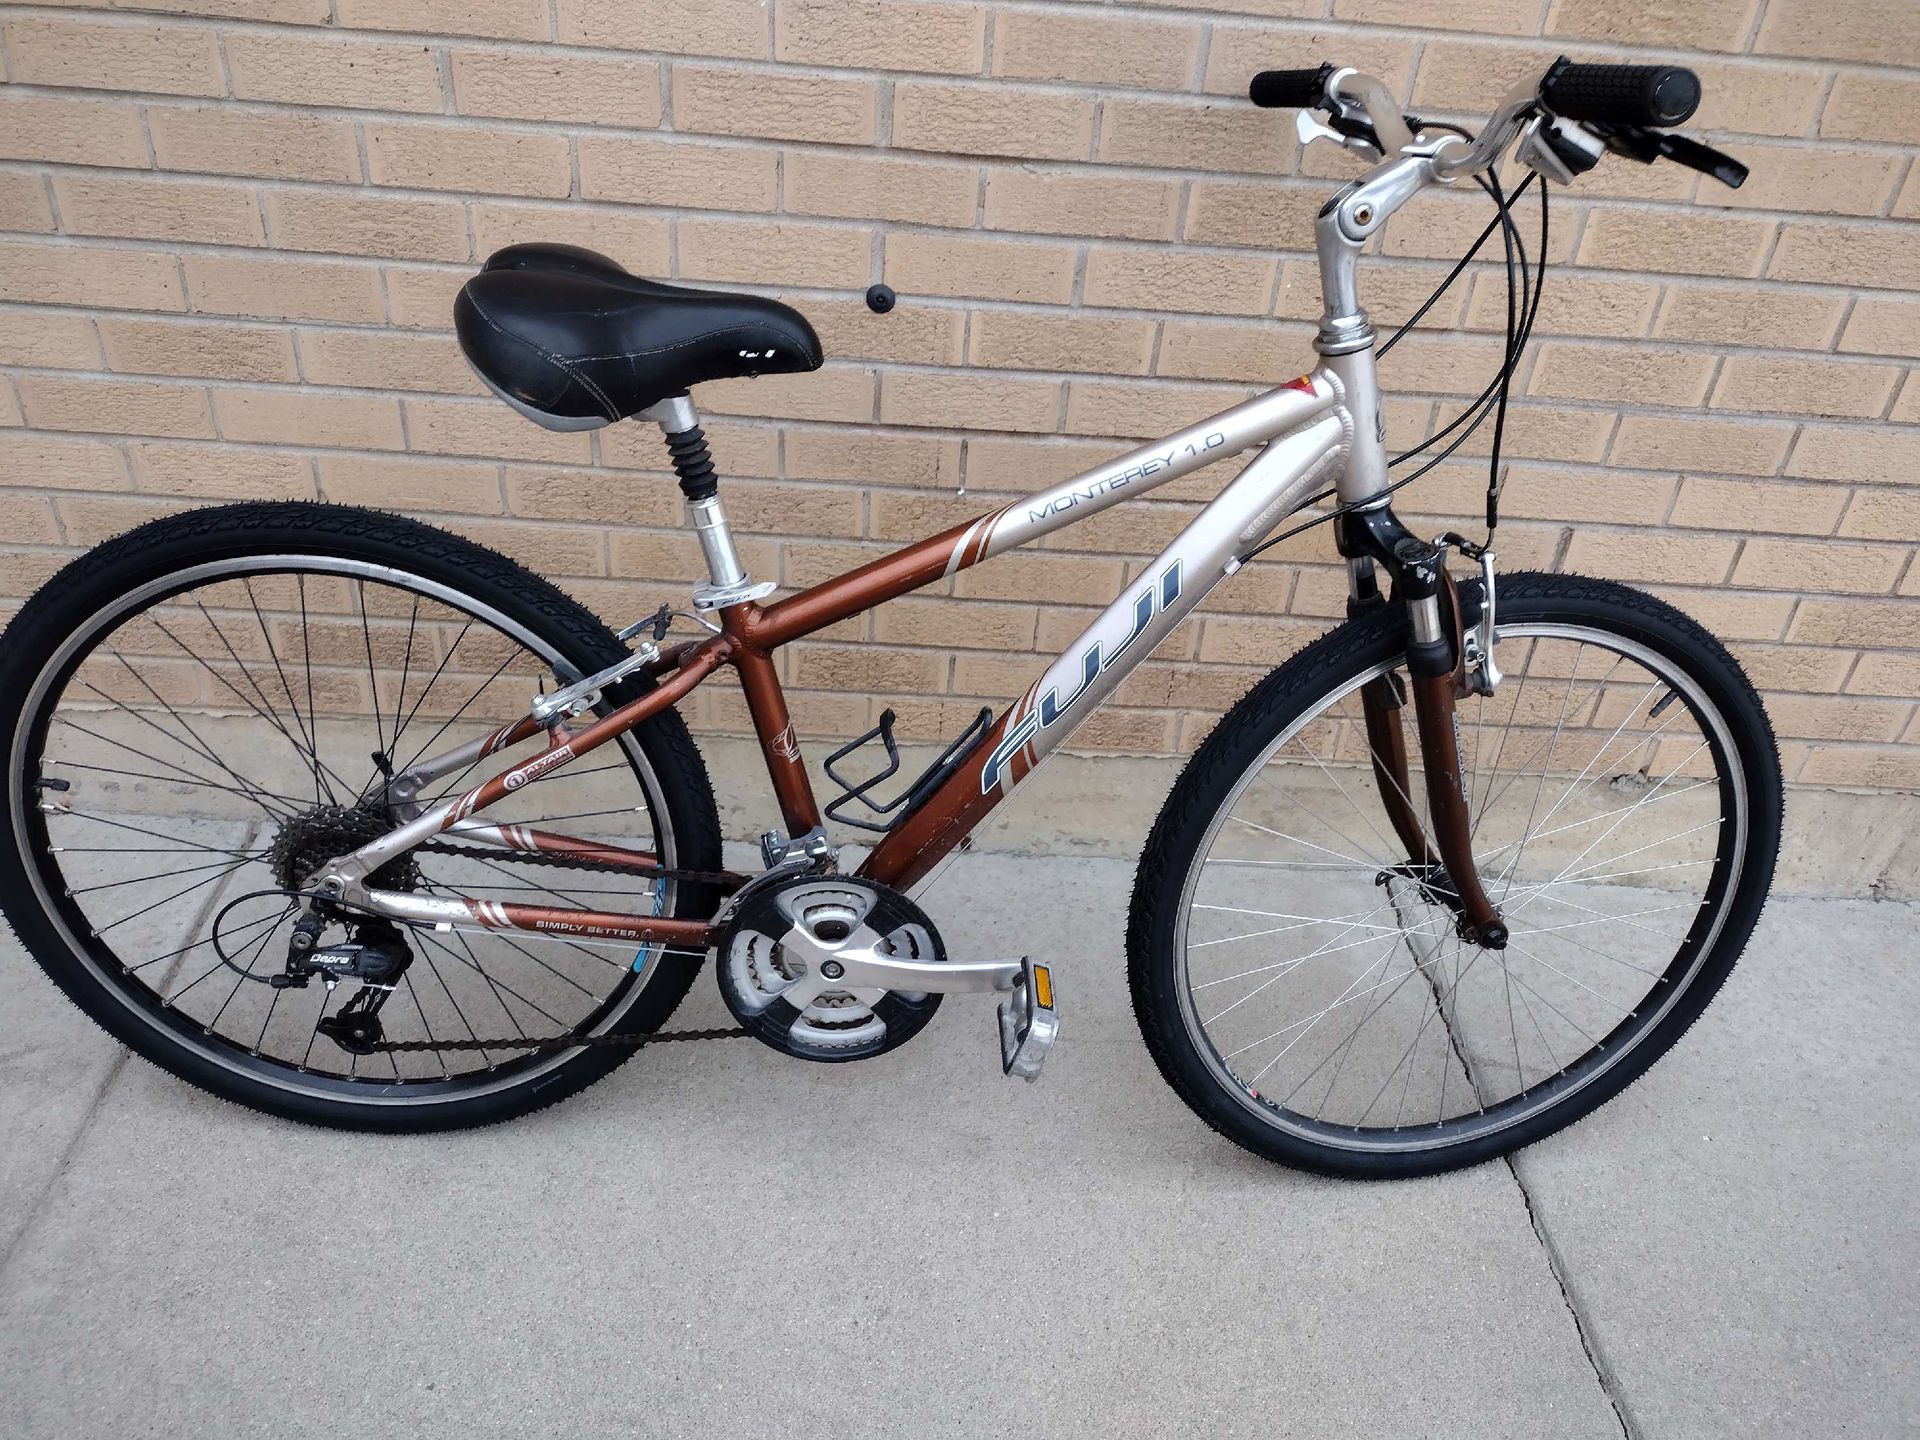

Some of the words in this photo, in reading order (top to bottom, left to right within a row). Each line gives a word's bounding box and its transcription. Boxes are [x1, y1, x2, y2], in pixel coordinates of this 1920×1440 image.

[1028, 450, 1176, 524] MONTEREY
[1184, 431, 1225, 457] 1.0
[981, 558, 1184, 795] FUJI
[536, 920, 584, 932] SIMPLY
